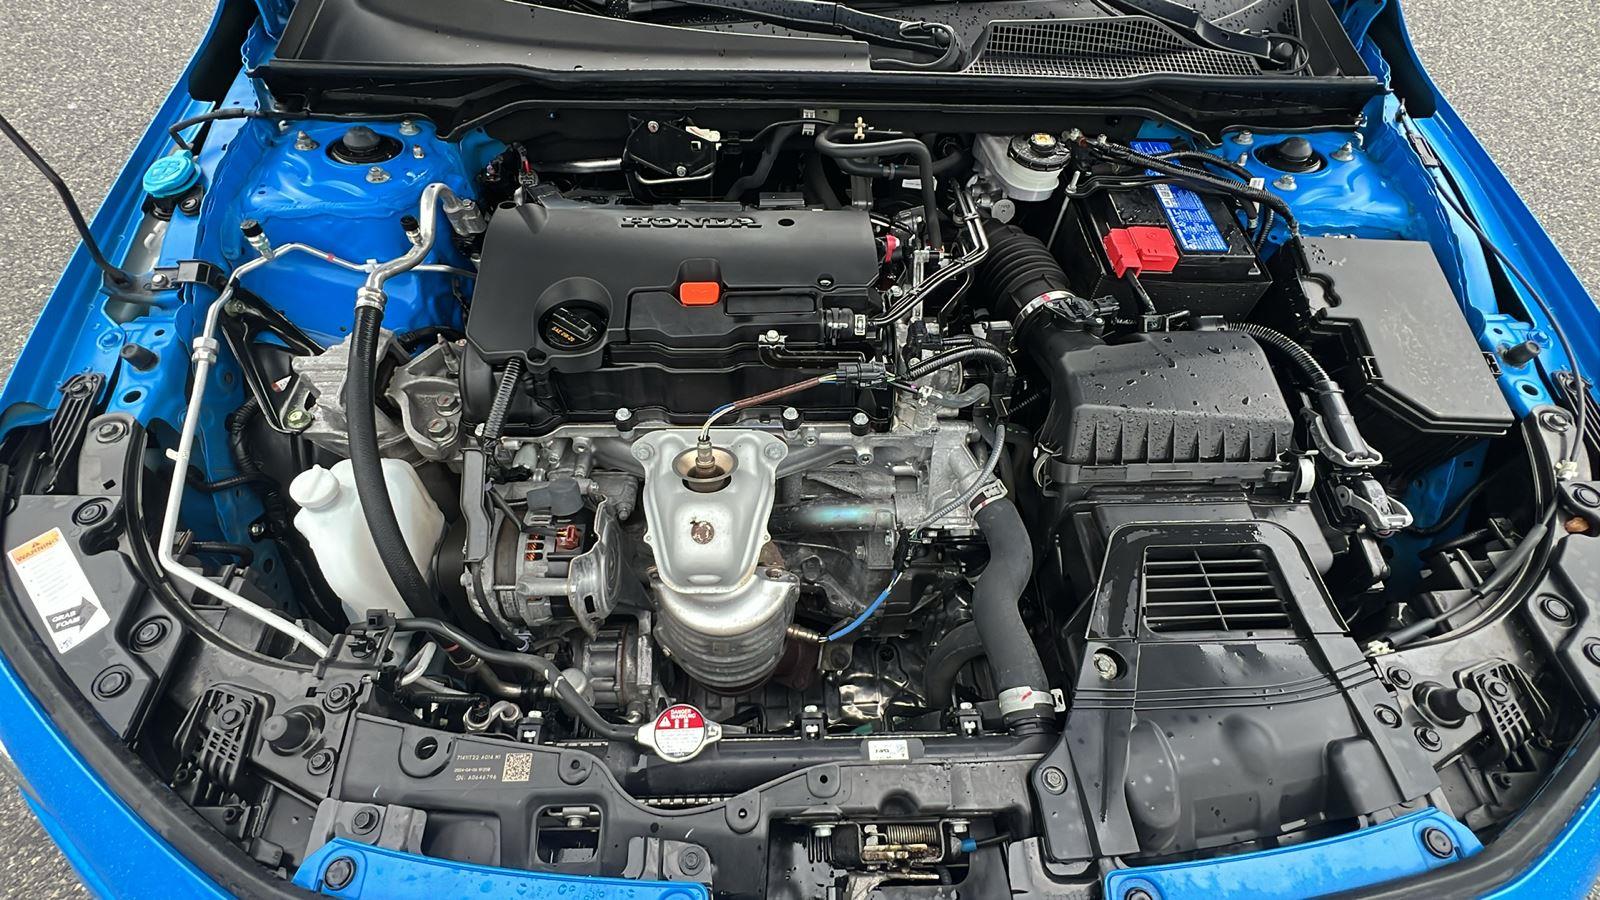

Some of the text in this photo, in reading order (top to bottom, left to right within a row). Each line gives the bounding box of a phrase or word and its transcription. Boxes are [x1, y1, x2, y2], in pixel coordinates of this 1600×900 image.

[620, 216, 762, 229] HONDA
[551, 326, 563, 335] SAE
[16, 537, 59, 562] WARNING
[51, 610, 77, 623] GRAB
[55, 616, 80, 630] FOAM
